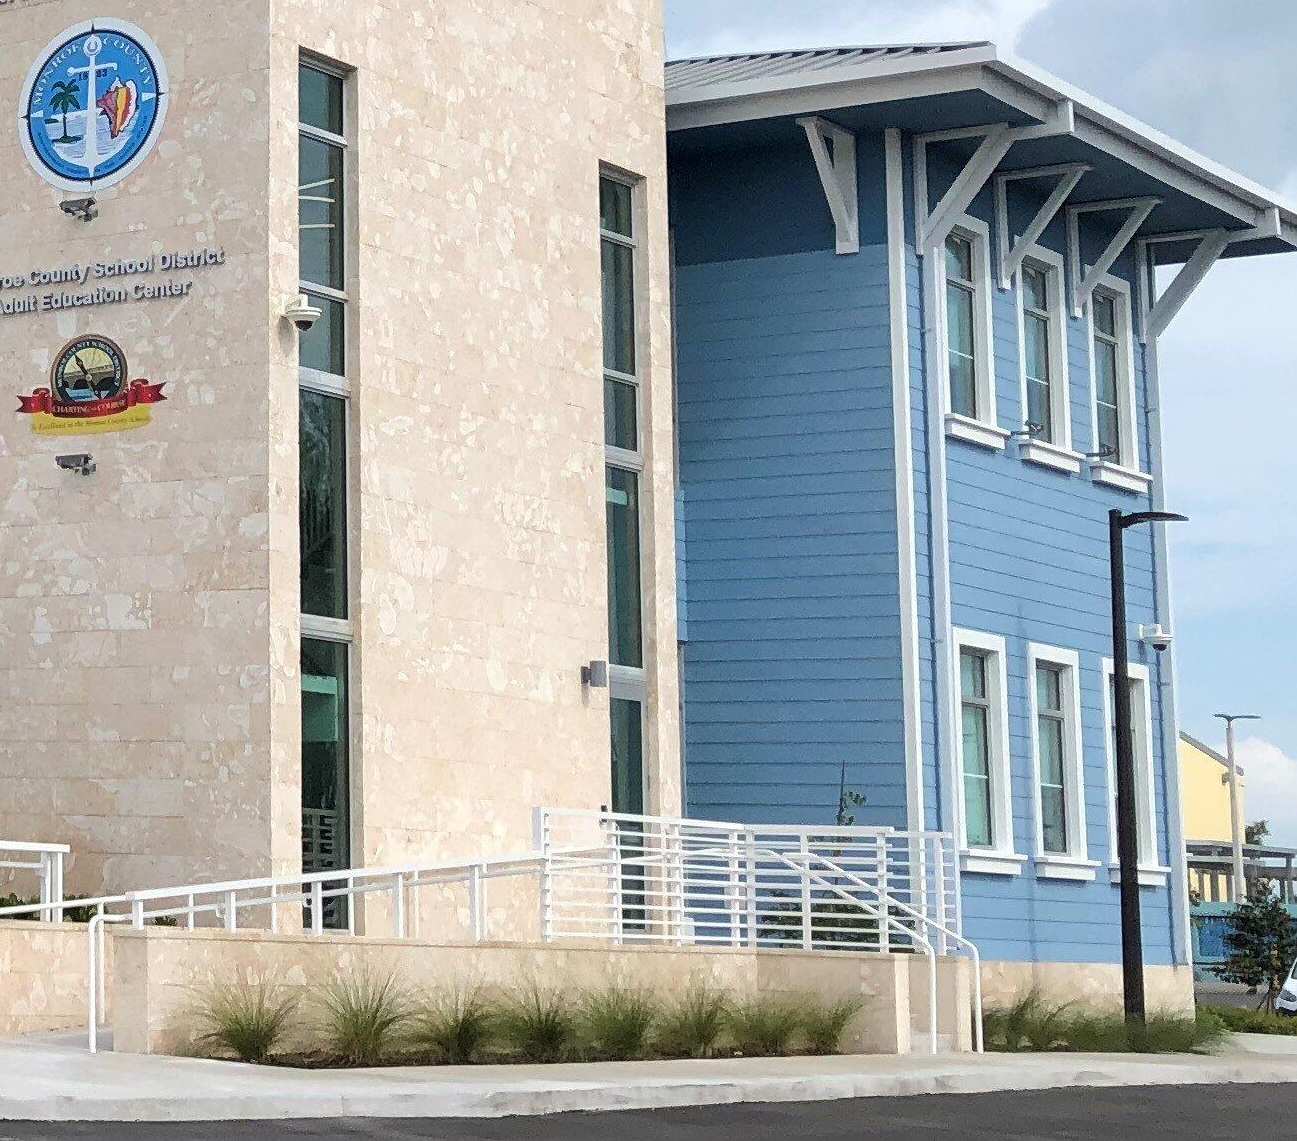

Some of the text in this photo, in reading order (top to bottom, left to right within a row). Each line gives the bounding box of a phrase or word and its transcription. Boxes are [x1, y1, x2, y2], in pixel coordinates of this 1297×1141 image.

[27, 264, 89, 285] County
[92, 256, 155, 278] School
[160, 246, 225, 270] District
[41, 285, 126, 311] Education
[130, 279, 192, 300] Center
